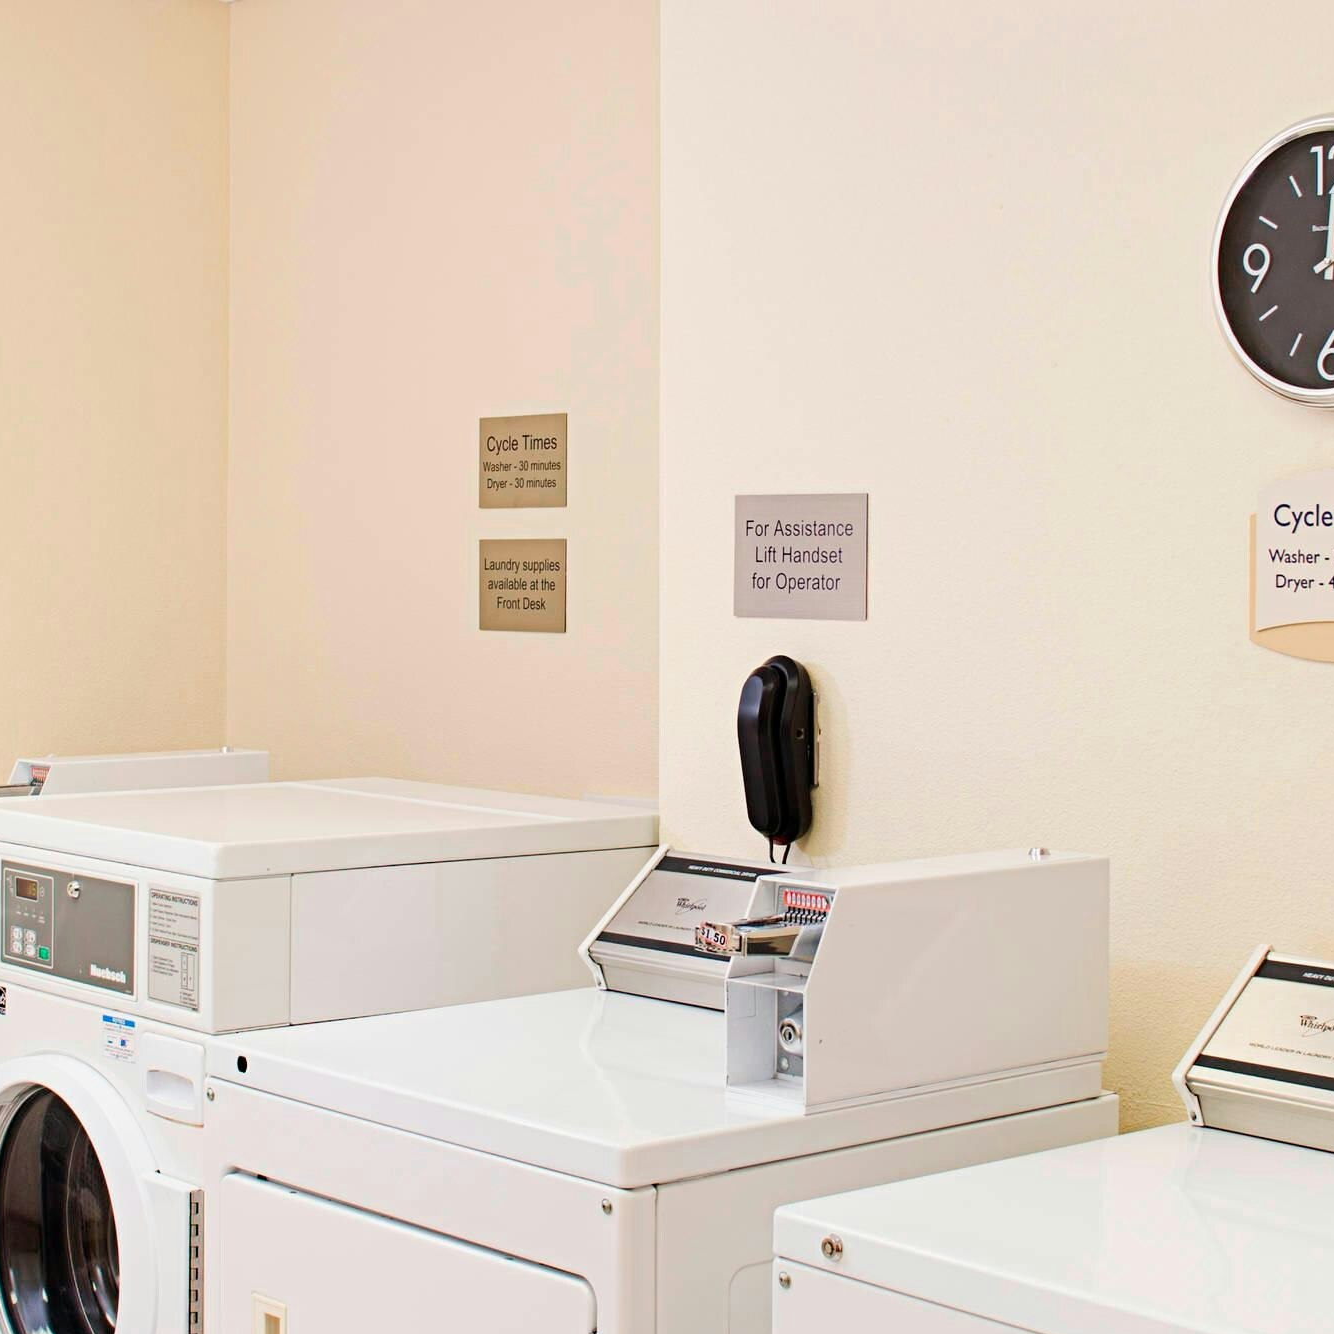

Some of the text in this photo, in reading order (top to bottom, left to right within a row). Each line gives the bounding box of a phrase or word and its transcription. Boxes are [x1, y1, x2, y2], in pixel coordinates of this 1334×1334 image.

[1243, 242, 1271, 293] 9
[486, 434, 558, 456] Cycle Times
[483, 460, 512, 473] Washer
[519, 460, 529, 472] 30
[530, 459, 561, 471] minutes
[487, 478, 507, 492] Dryer
[515, 477, 525, 489] 30
[526, 476, 557, 488] minutes
[1273, 503, 1333, 534] Cycle
[745, 520, 854, 537] For Assistance
[755, 546, 843, 564] Lift Handset
[1268, 548, 1320, 564] Washer
[484, 558, 561, 574] Laundry supplies
[487, 578, 555, 592] available at the
[752, 572, 841, 594] for Operator
[1275, 574, 1315, 593] Dryer
[496, 596, 546, 611] Front Desk
[1302, 972, 1325, 980] HEAVY
